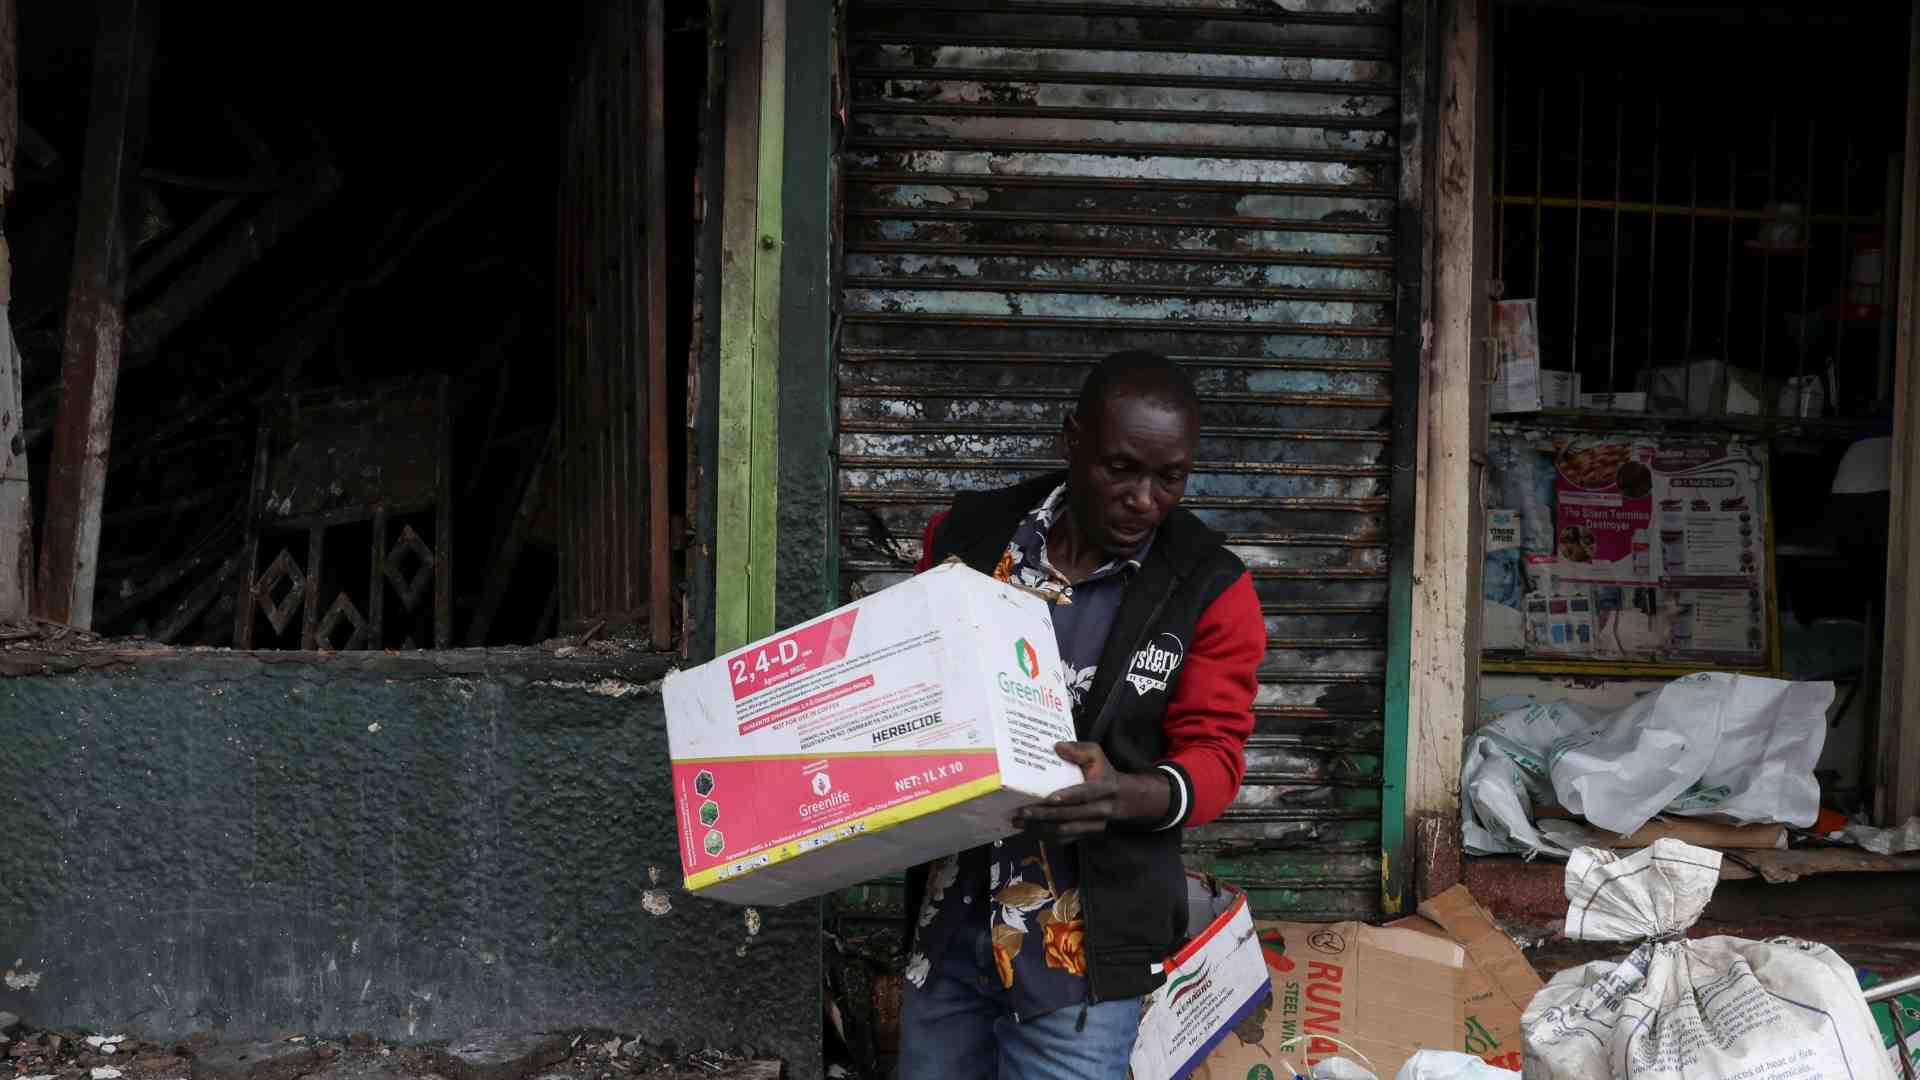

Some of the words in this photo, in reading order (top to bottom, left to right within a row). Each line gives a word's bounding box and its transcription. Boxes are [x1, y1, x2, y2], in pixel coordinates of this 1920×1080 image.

[733, 640, 798, 685] 2,4-D
[998, 671, 1064, 712] Greenlife
[872, 712, 943, 743] HERBICIDE
[895, 774, 921, 793] NET:
[923, 769, 937, 785] 1L
[937, 766, 948, 779] X
[949, 760, 964, 775] 10
[800, 791, 849, 816] Greenlife
[1283, 979, 1299, 1016] STEEL
[1301, 960, 1345, 1068] RUNA
